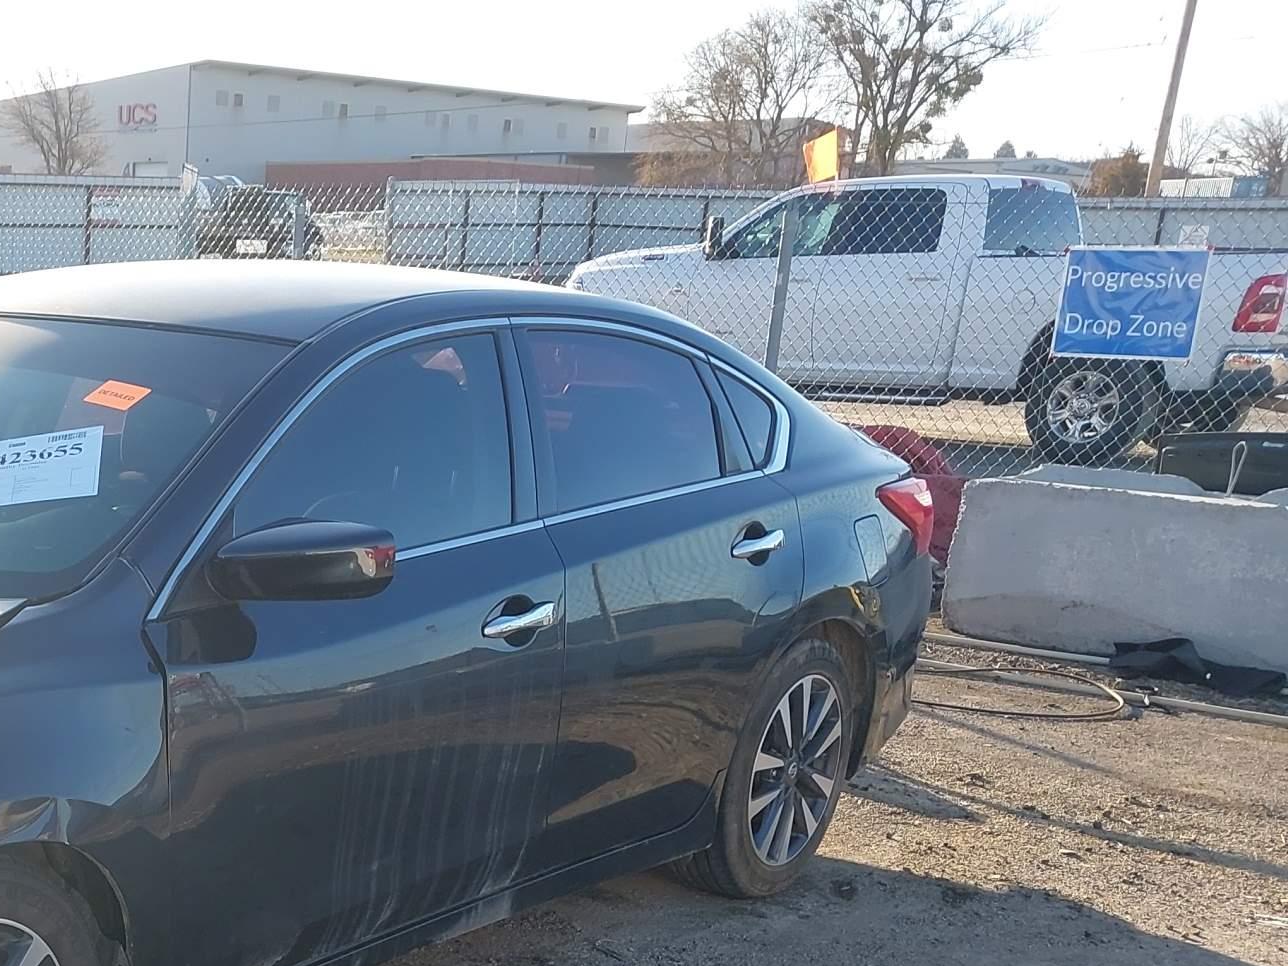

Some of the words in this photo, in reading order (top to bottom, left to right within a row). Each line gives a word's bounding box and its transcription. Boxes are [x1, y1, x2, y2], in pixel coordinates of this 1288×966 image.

[119, 103, 157, 125] UCS
[1066, 264, 1203, 292] Progressive
[1063, 312, 1122, 340] Drop
[1126, 314, 1188, 338] Zone
